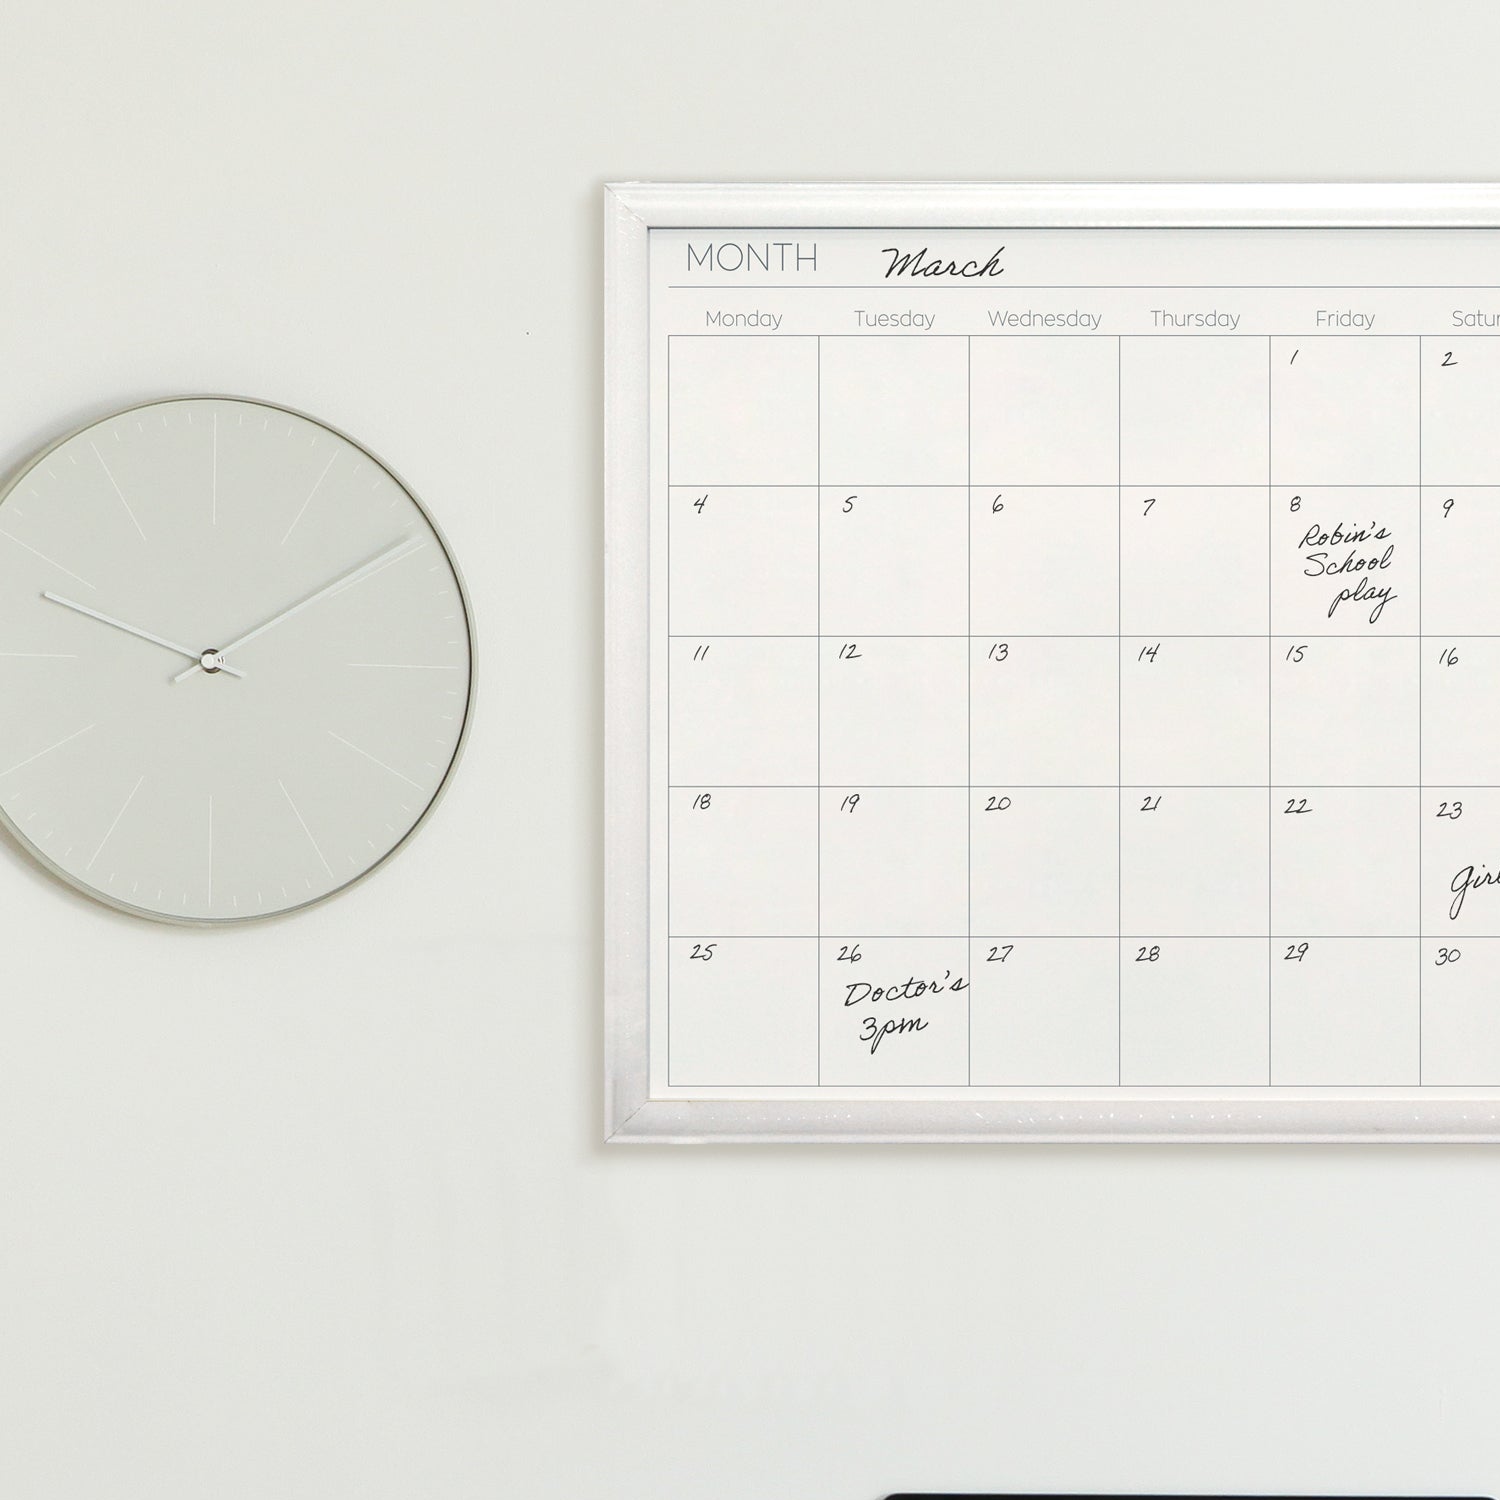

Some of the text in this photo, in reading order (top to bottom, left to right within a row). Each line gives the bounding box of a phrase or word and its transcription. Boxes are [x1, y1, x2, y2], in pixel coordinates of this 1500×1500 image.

[686, 242, 817, 272] MONTH
[881, 245, 1006, 279] March
[706, 309, 783, 331] Monday
[853, 309, 936, 331] Tuesday
[987, 309, 1103, 331] Wednesday
[1150, 309, 1241, 331] Thursday
[1315, 309, 1376, 331] Friday
[1289, 349, 1300, 366] 1
[1440, 351, 1459, 368] 2
[693, 494, 709, 515] 4
[842, 495, 858, 514] 5
[991, 493, 1005, 515] 6
[1143, 498, 1157, 517] 7
[1289, 495, 1302, 513] 8
[1442, 498, 1455, 519] 9
[1297, 520, 1393, 550] Robin's
[1303, 544, 1395, 578] School
[1327, 576, 1399, 625] play
[693, 644, 711, 662] 11
[838, 643, 863, 660] 12
[988, 642, 1009, 662] 13
[1137, 642, 1161, 664] 14
[1285, 644, 1309, 663] 15
[1438, 646, 1460, 668] 16
[692, 792, 713, 811] 18
[840, 793, 861, 814] 19
[984, 795, 1012, 812] 20
[1139, 795, 1163, 812] 21
[1283, 798, 1314, 815] 22
[1435, 801, 1463, 821] 23
[689, 943, 718, 963] 25
[836, 943, 863, 965] 26
[985, 944, 1015, 963] 27
[1134, 944, 1161, 963] 28
[1283, 942, 1310, 964] 29
[1434, 947, 1462, 967] 30
[843, 969, 970, 1008] Doctor's
[858, 1016, 930, 1056] 3pm
